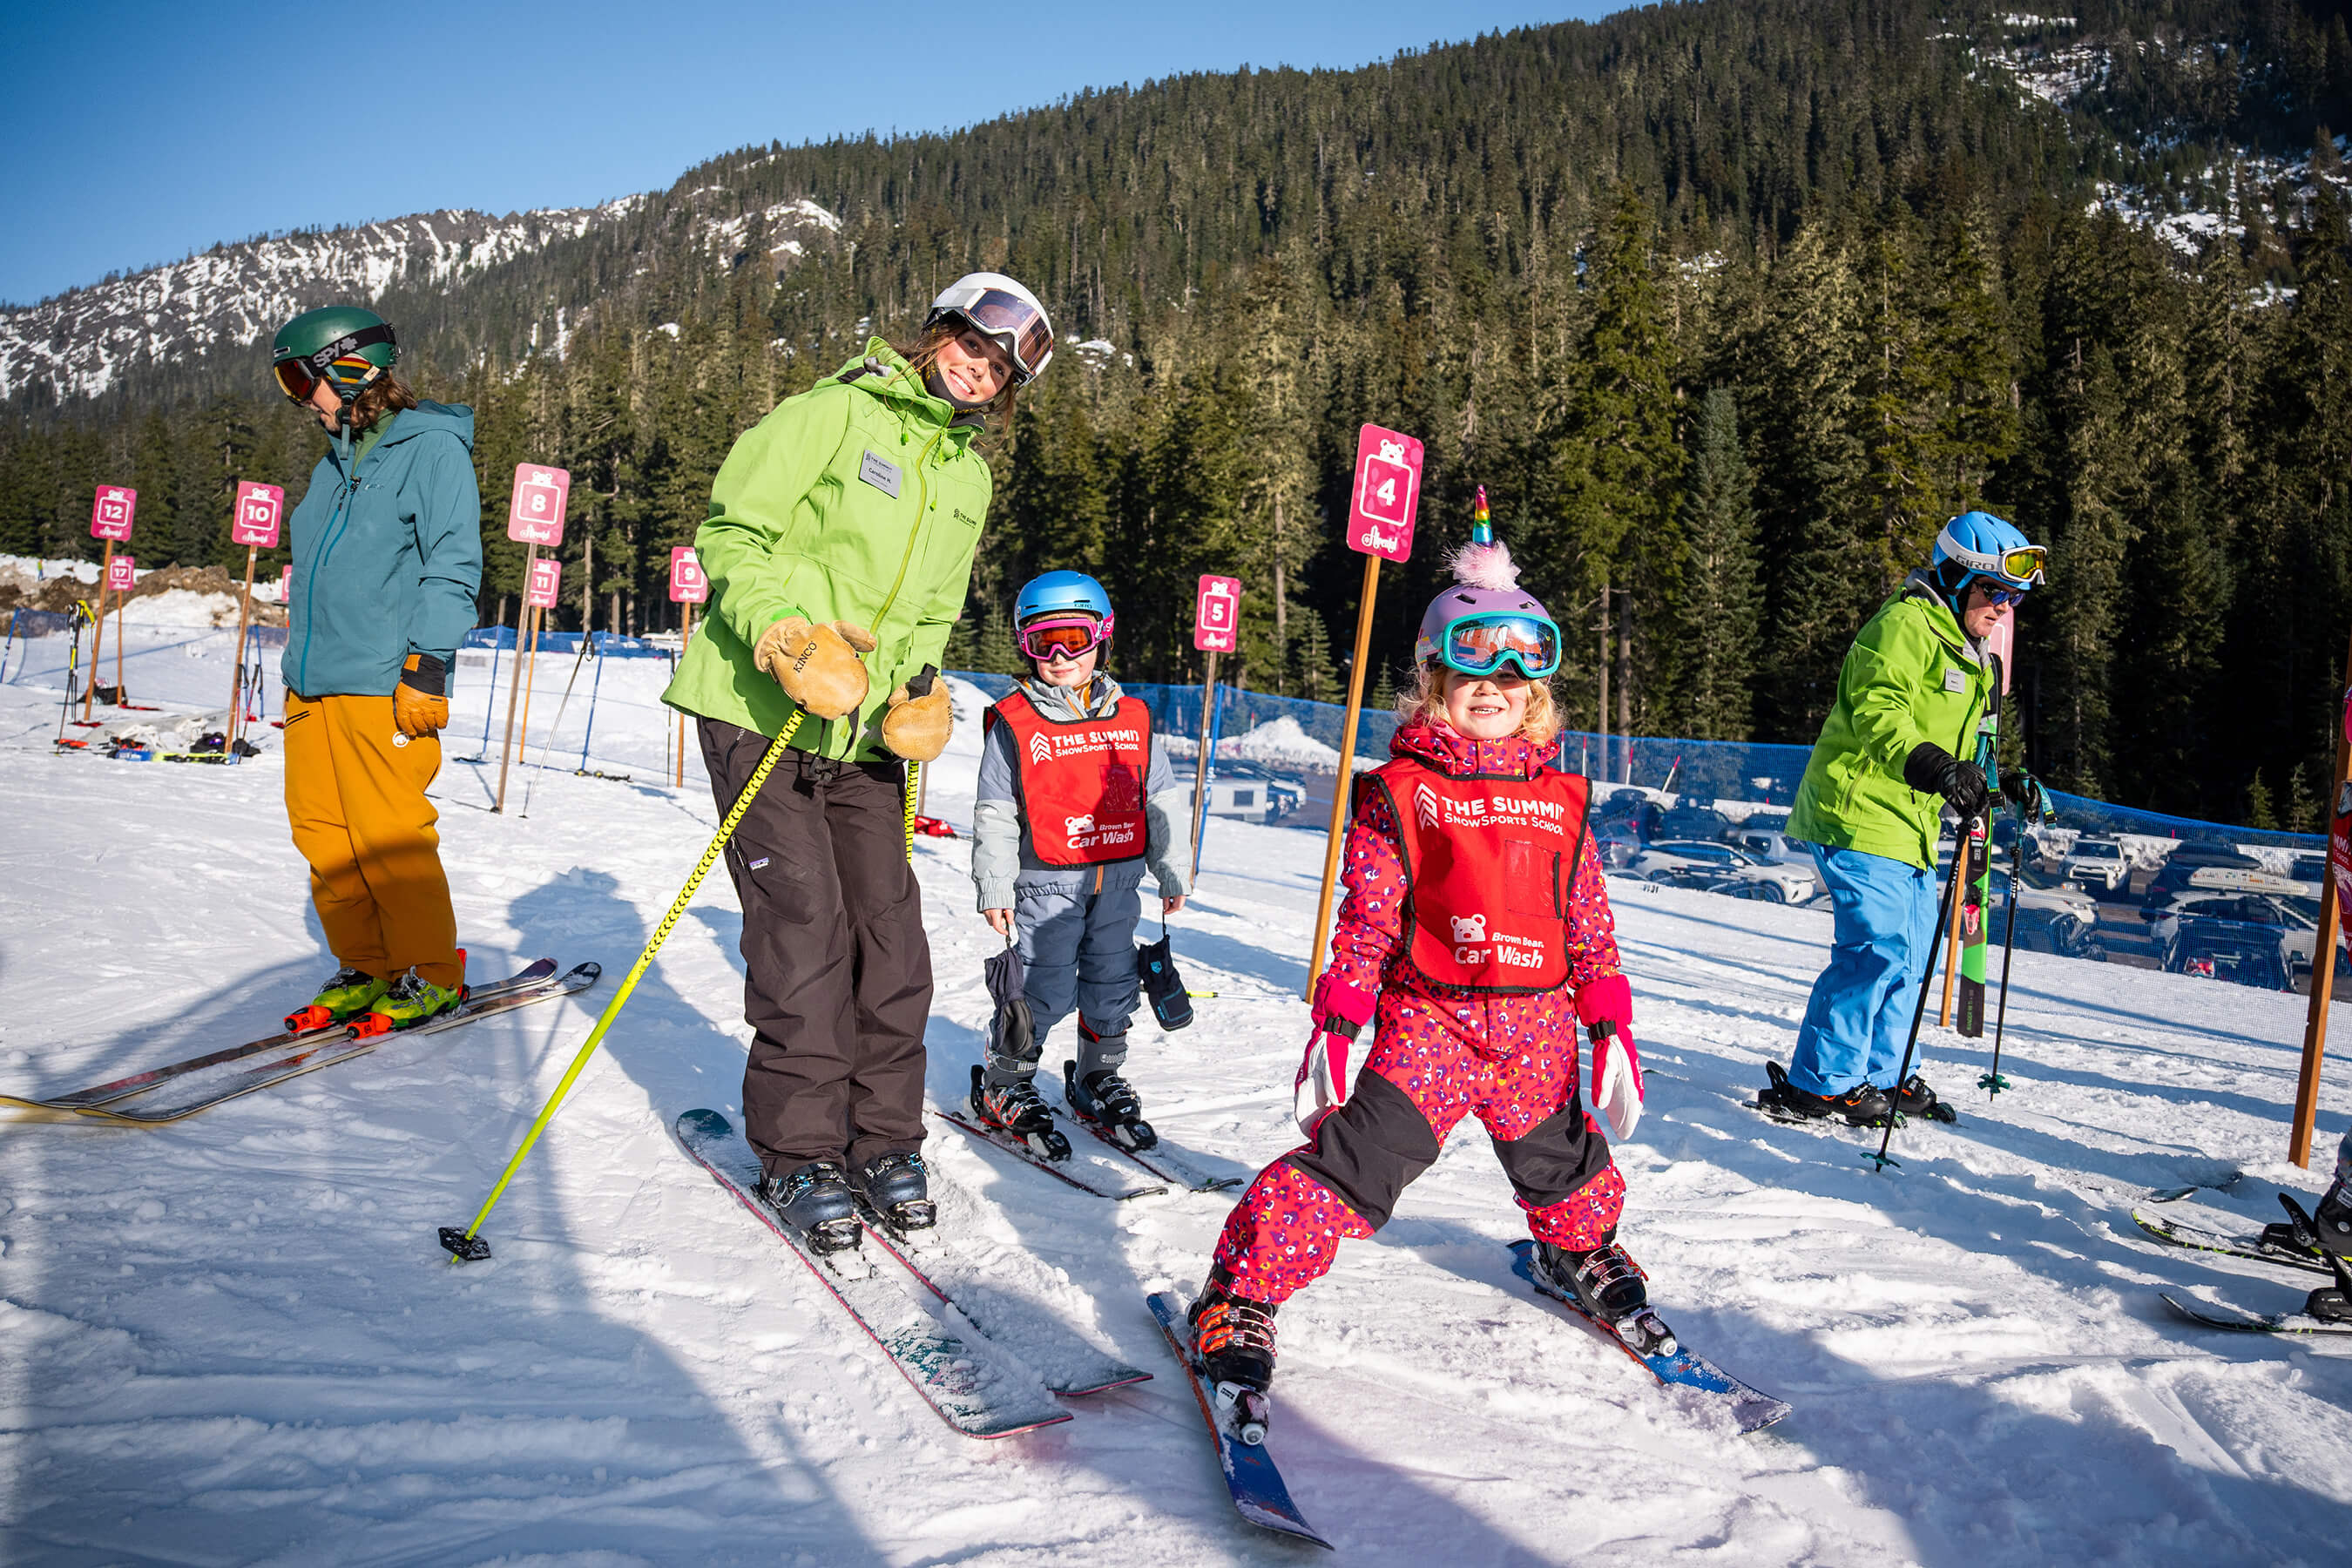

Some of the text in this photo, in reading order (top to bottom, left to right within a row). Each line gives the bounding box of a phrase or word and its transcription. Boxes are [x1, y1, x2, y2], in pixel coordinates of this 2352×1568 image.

[313, 341, 340, 368] SPY
[1376, 477, 1396, 507] 4
[105, 504, 123, 519] 12
[531, 494, 546, 512] 8
[247, 505, 269, 522] 10
[1956, 554, 1995, 571] GIRO
[114, 568, 127, 578] 17
[684, 567, 695, 581] 9
[536, 576, 549, 589] 11
[1211, 603, 1224, 621] 5
[793, 641, 817, 674] KINCO
[1051, 729, 1139, 747] THE SUMMIT
[1441, 795, 1565, 821] THE SUMMIT
[1067, 828, 1134, 849] Car Wash
[1491, 932, 1522, 945] Brown
[1455, 944, 1544, 969] Car Wash
